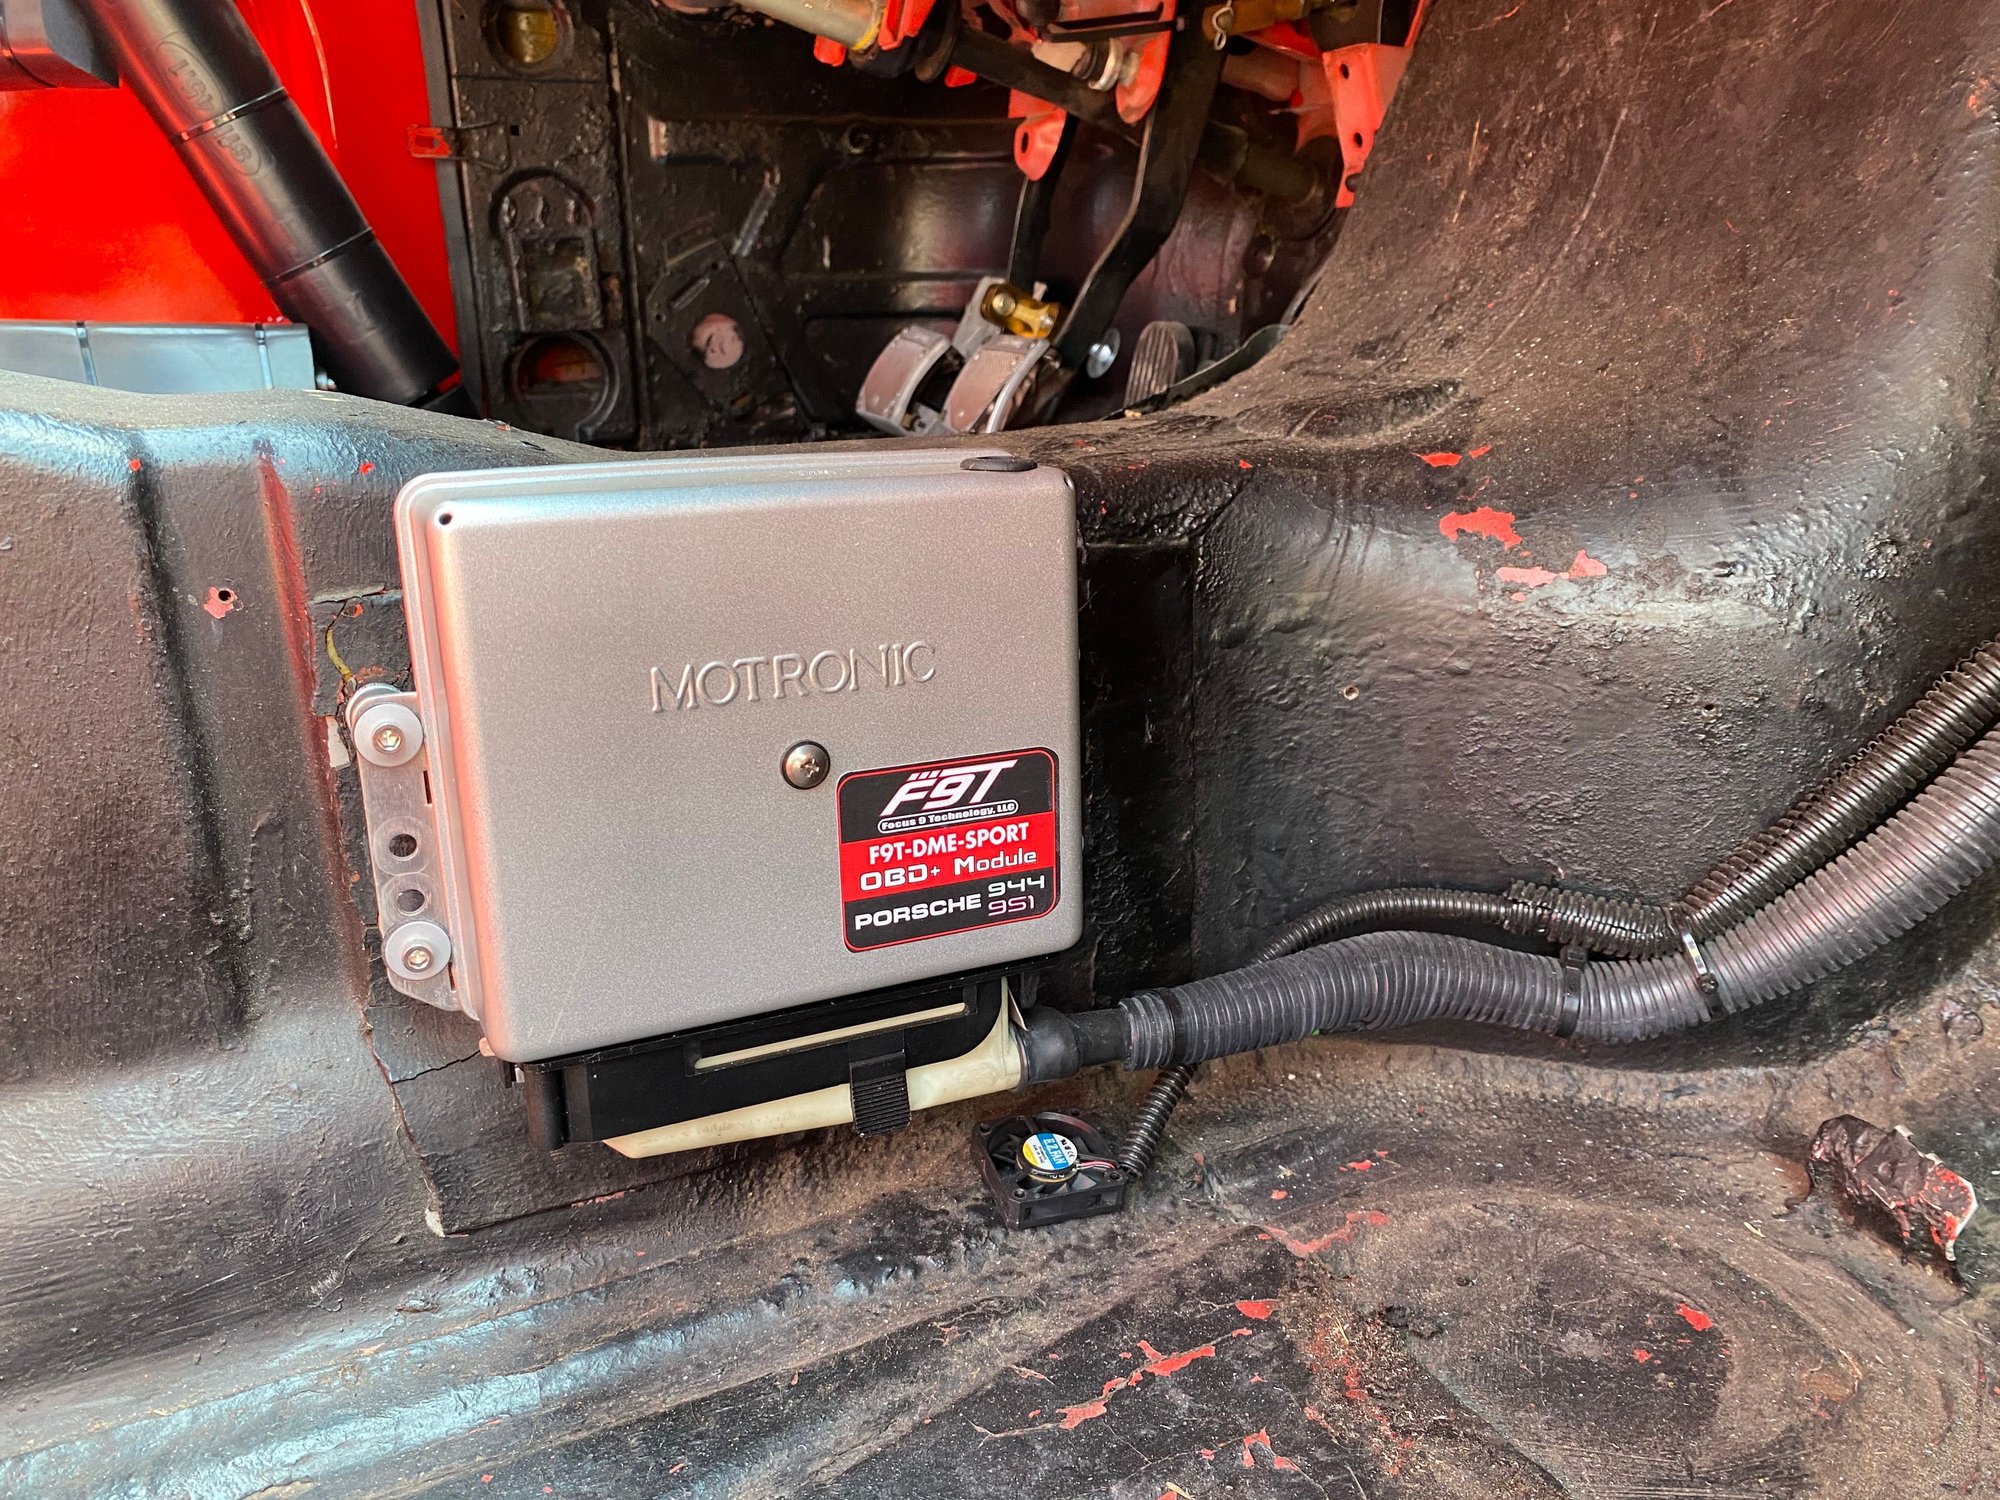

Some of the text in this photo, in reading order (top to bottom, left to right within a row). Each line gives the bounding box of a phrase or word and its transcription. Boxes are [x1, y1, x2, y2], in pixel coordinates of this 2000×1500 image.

[650, 640, 936, 713] MOTRONIC
[879, 758, 1019, 817] F9T
[881, 818, 917, 831] Focus
[918, 816, 927, 825] 9
[997, 803, 1016, 813] LLC
[869, 822, 1030, 865] F9T-DME-SPORT
[859, 848, 1037, 891] OBD+ Module
[855, 874, 1045, 931] PORSCHE 944
[988, 894, 1035, 917] 951
